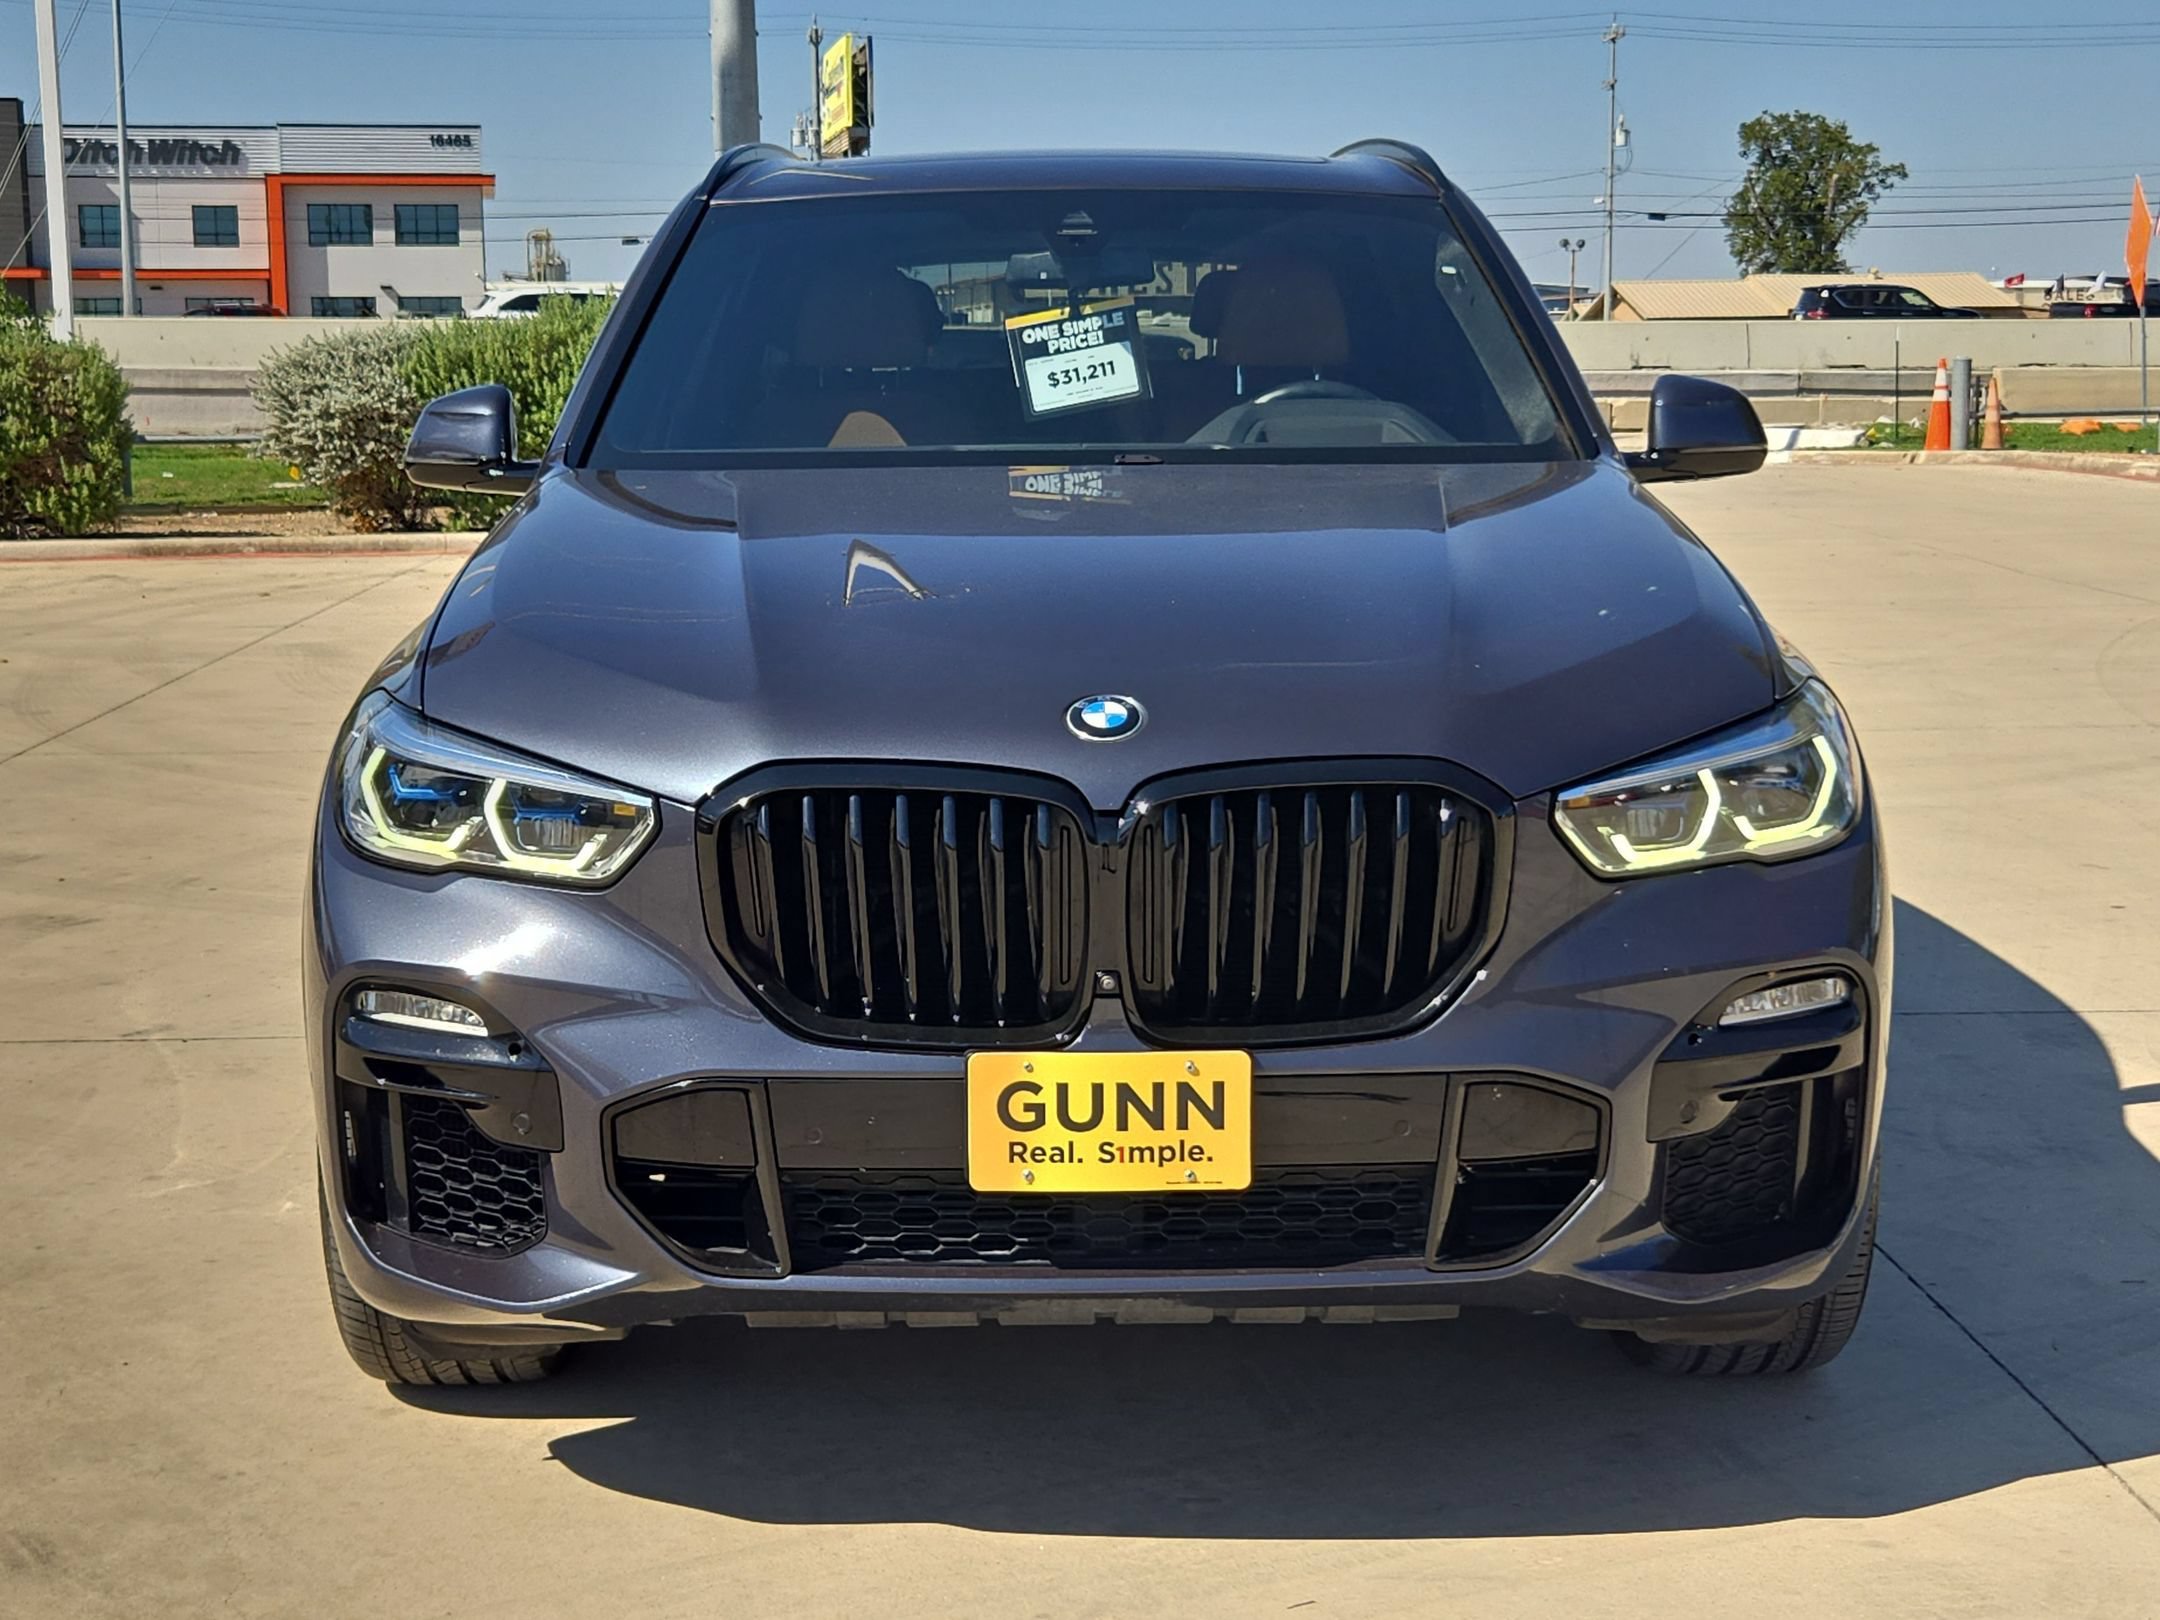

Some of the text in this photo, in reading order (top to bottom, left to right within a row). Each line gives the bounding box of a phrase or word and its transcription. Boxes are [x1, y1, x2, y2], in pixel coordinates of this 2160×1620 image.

[147, 138, 241, 165] Witch
[430, 134, 472, 147] 16465
[1022, 312, 1124, 345] ONE SIMPLE
[1047, 330, 1104, 353] PRICE!
[1047, 360, 1116, 388] $31,211
[996, 1080, 1225, 1133] GUNN
[1008, 1140, 1083, 1164] Real.
